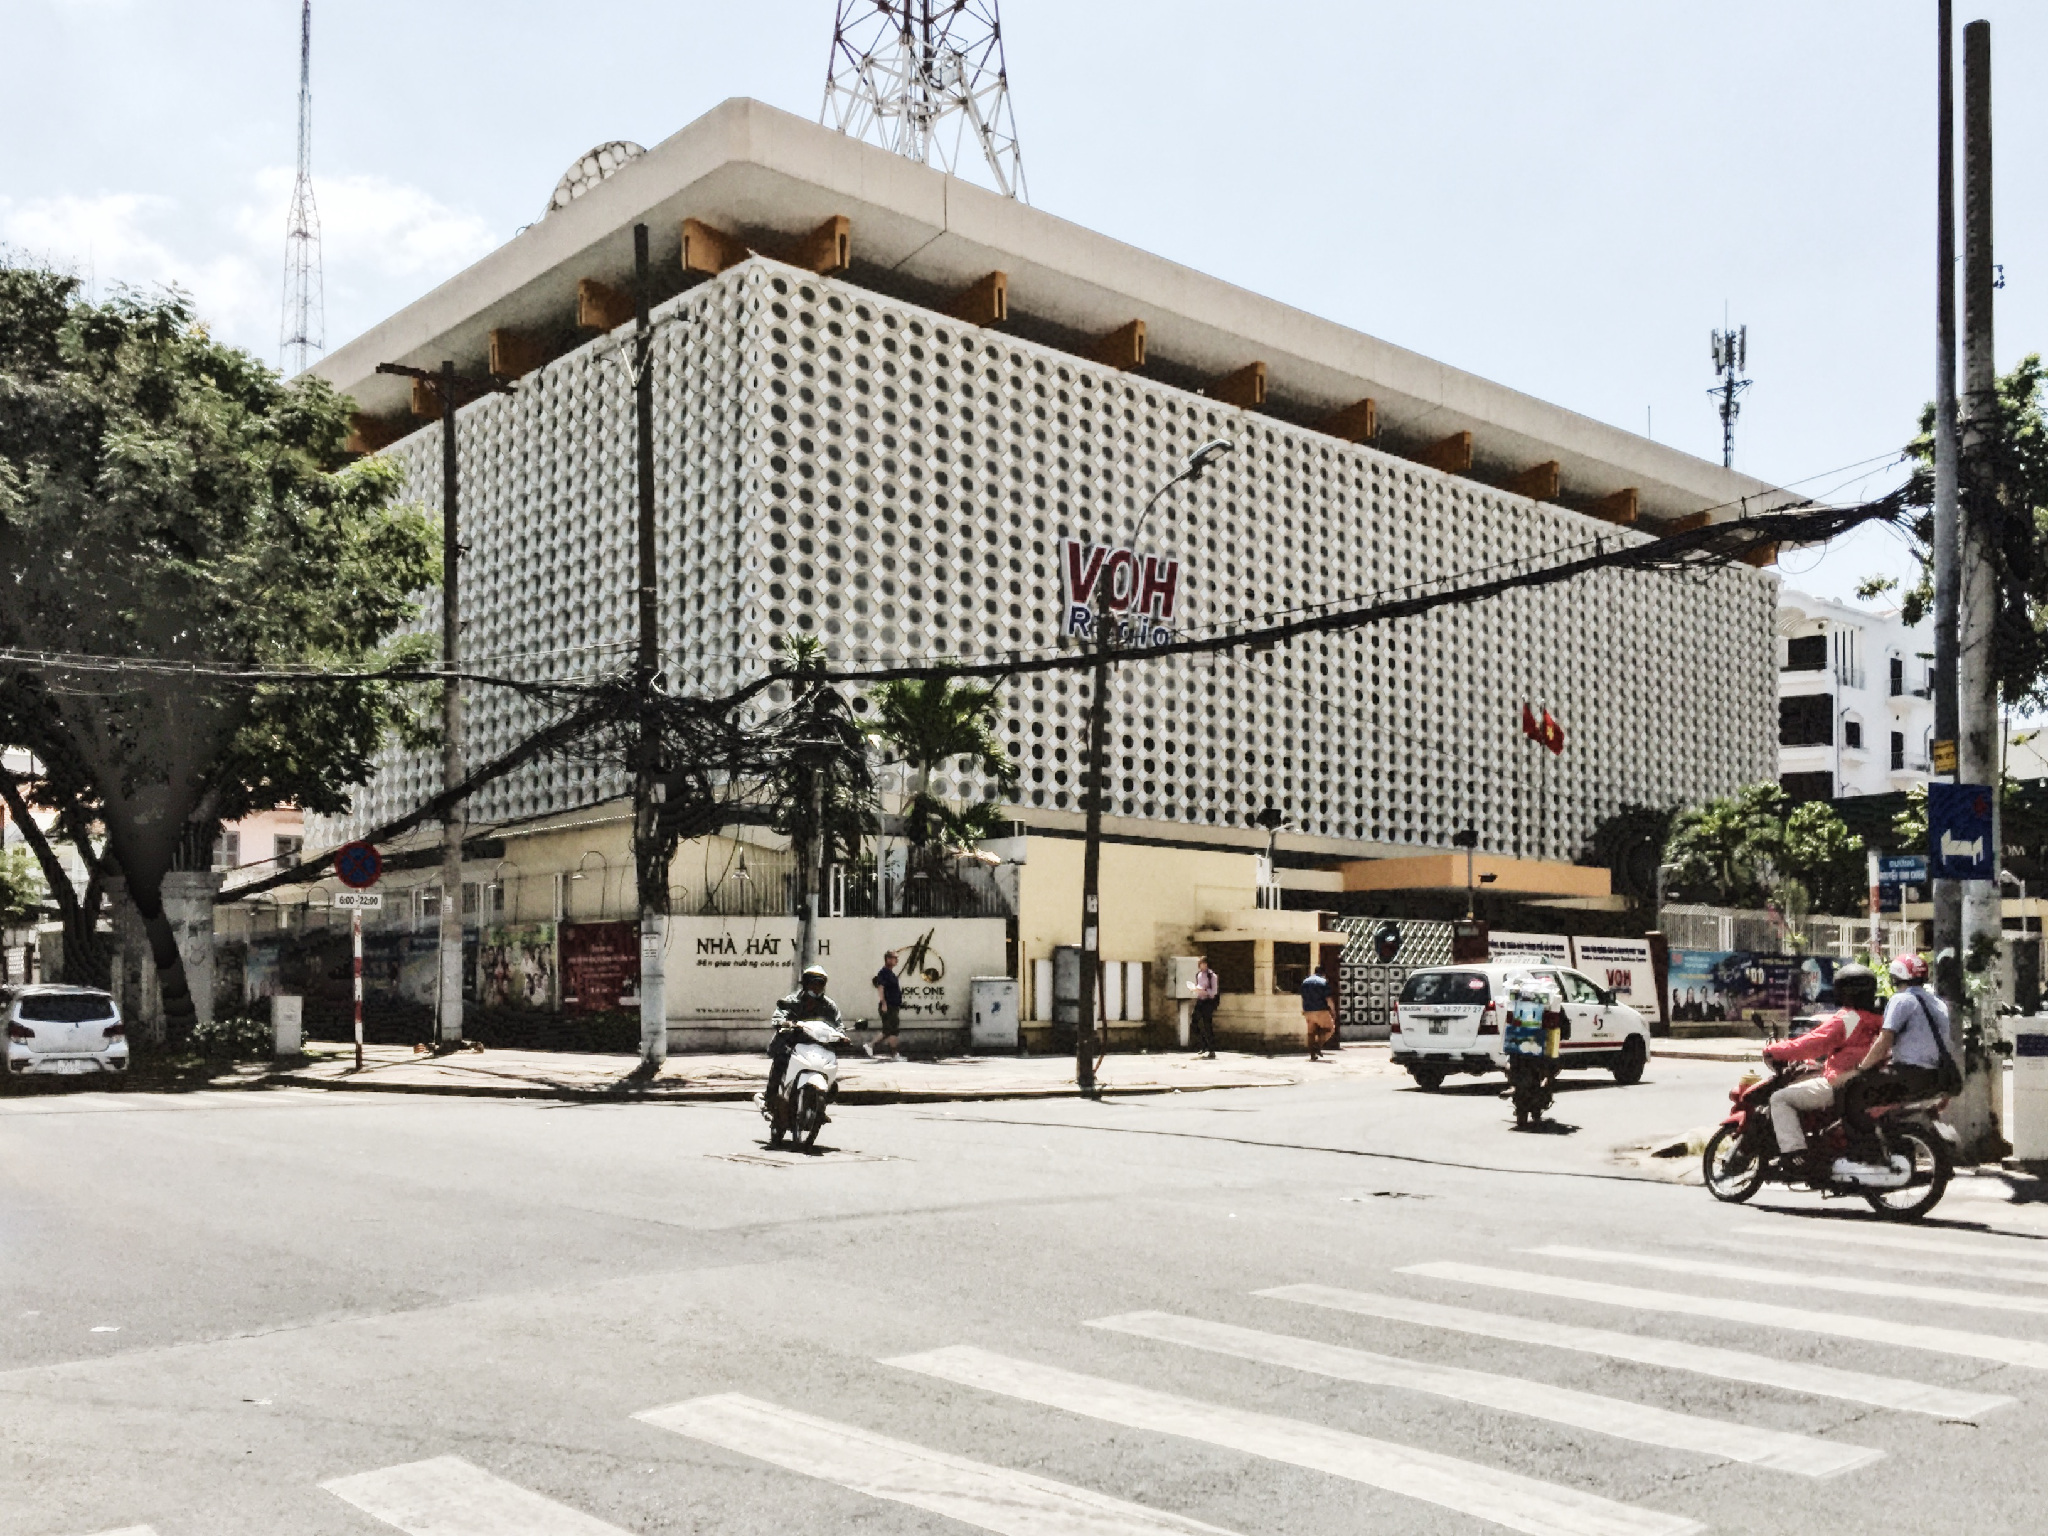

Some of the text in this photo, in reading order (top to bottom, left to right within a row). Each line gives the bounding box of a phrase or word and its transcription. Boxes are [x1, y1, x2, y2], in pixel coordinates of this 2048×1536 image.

[1066, 539, 1179, 618] VOH
[1069, 606, 1170, 647] Rdio
[339, 896, 355, 905] 6:00
[360, 896, 379, 905] 22:00
[696, 932, 831, 955] NHÀ HÁT VH
[1606, 968, 1632, 987] VOH
[901, 986, 945, 996] SIC ONE
